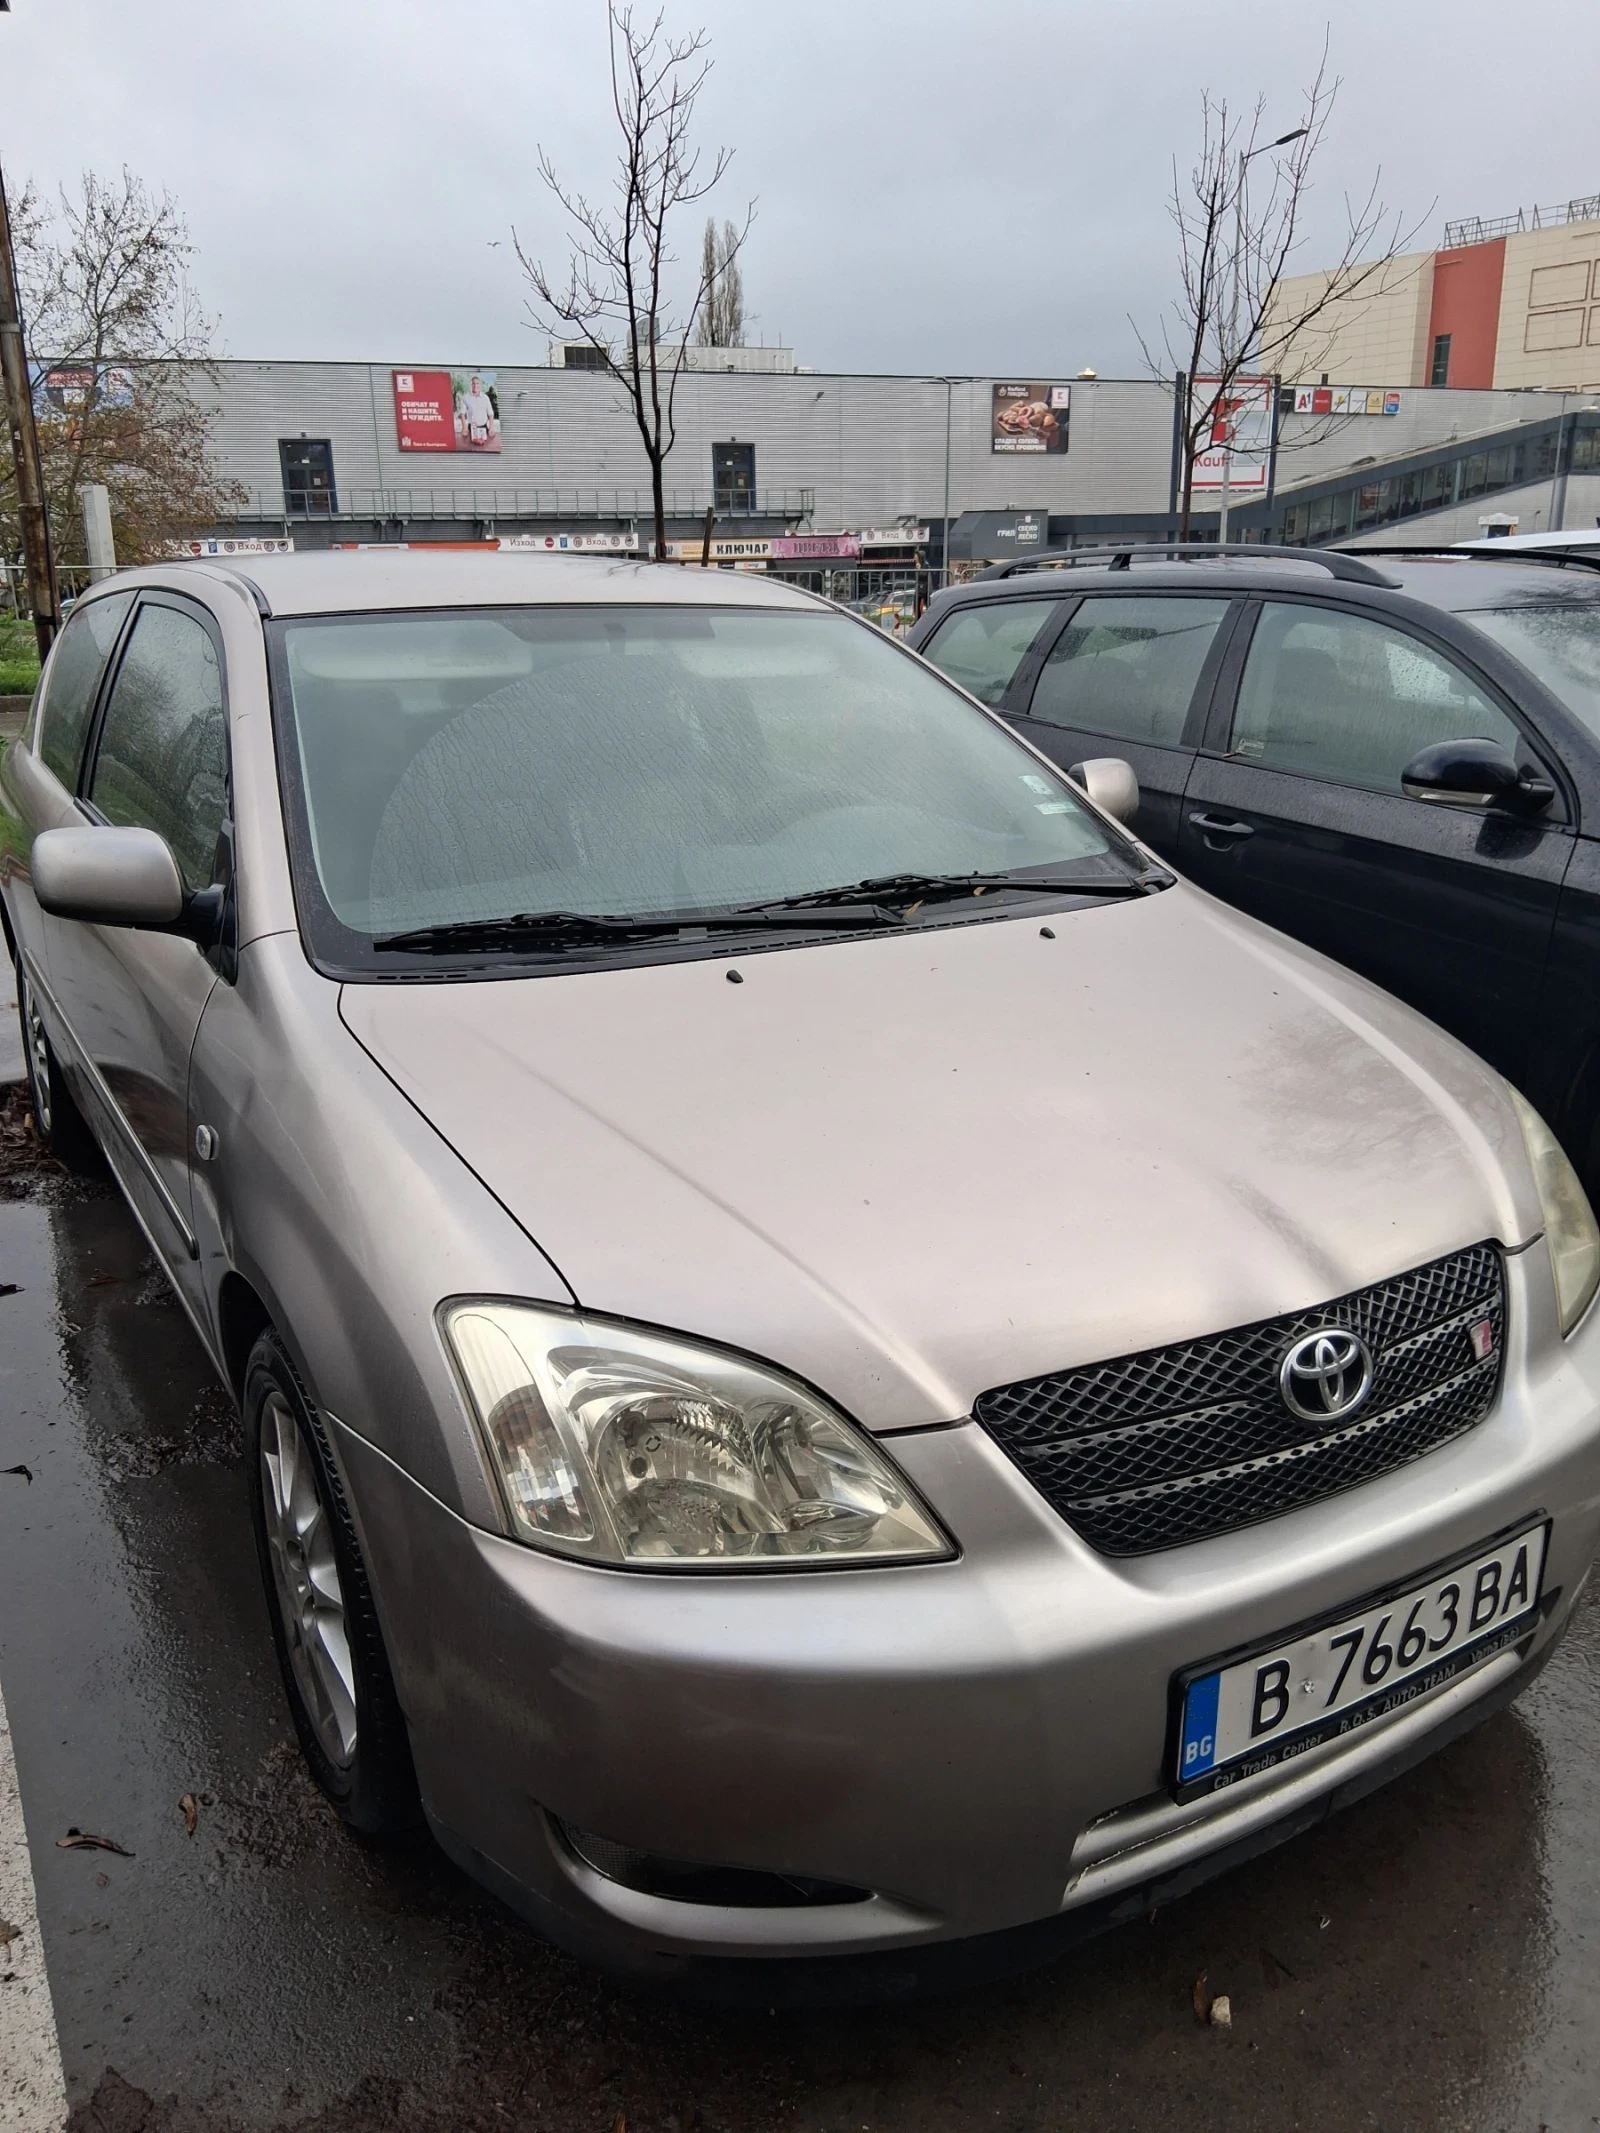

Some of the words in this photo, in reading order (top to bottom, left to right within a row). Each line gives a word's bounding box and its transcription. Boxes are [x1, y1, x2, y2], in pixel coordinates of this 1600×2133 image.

[1297, 392, 1311, 409] A1
[1194, 451, 1225, 468] Kauf
[586, 537, 607, 546] Вход
[881, 531, 899, 539] Вход
[238, 542, 263, 551] Вход
[510, 538, 535, 547] Изход
[716, 544, 769, 555] КЛЮЧАР
[1250, 1660, 1291, 1739] B
[1325, 1582, 1461, 1708] 7663
[1468, 1543, 1529, 1633] BA
[1186, 1735, 1213, 1765] BG
[1213, 1770, 1236, 1790] Car
[1241, 1754, 1277, 1778] Trade
[1282, 1732, 1324, 1761] Center
